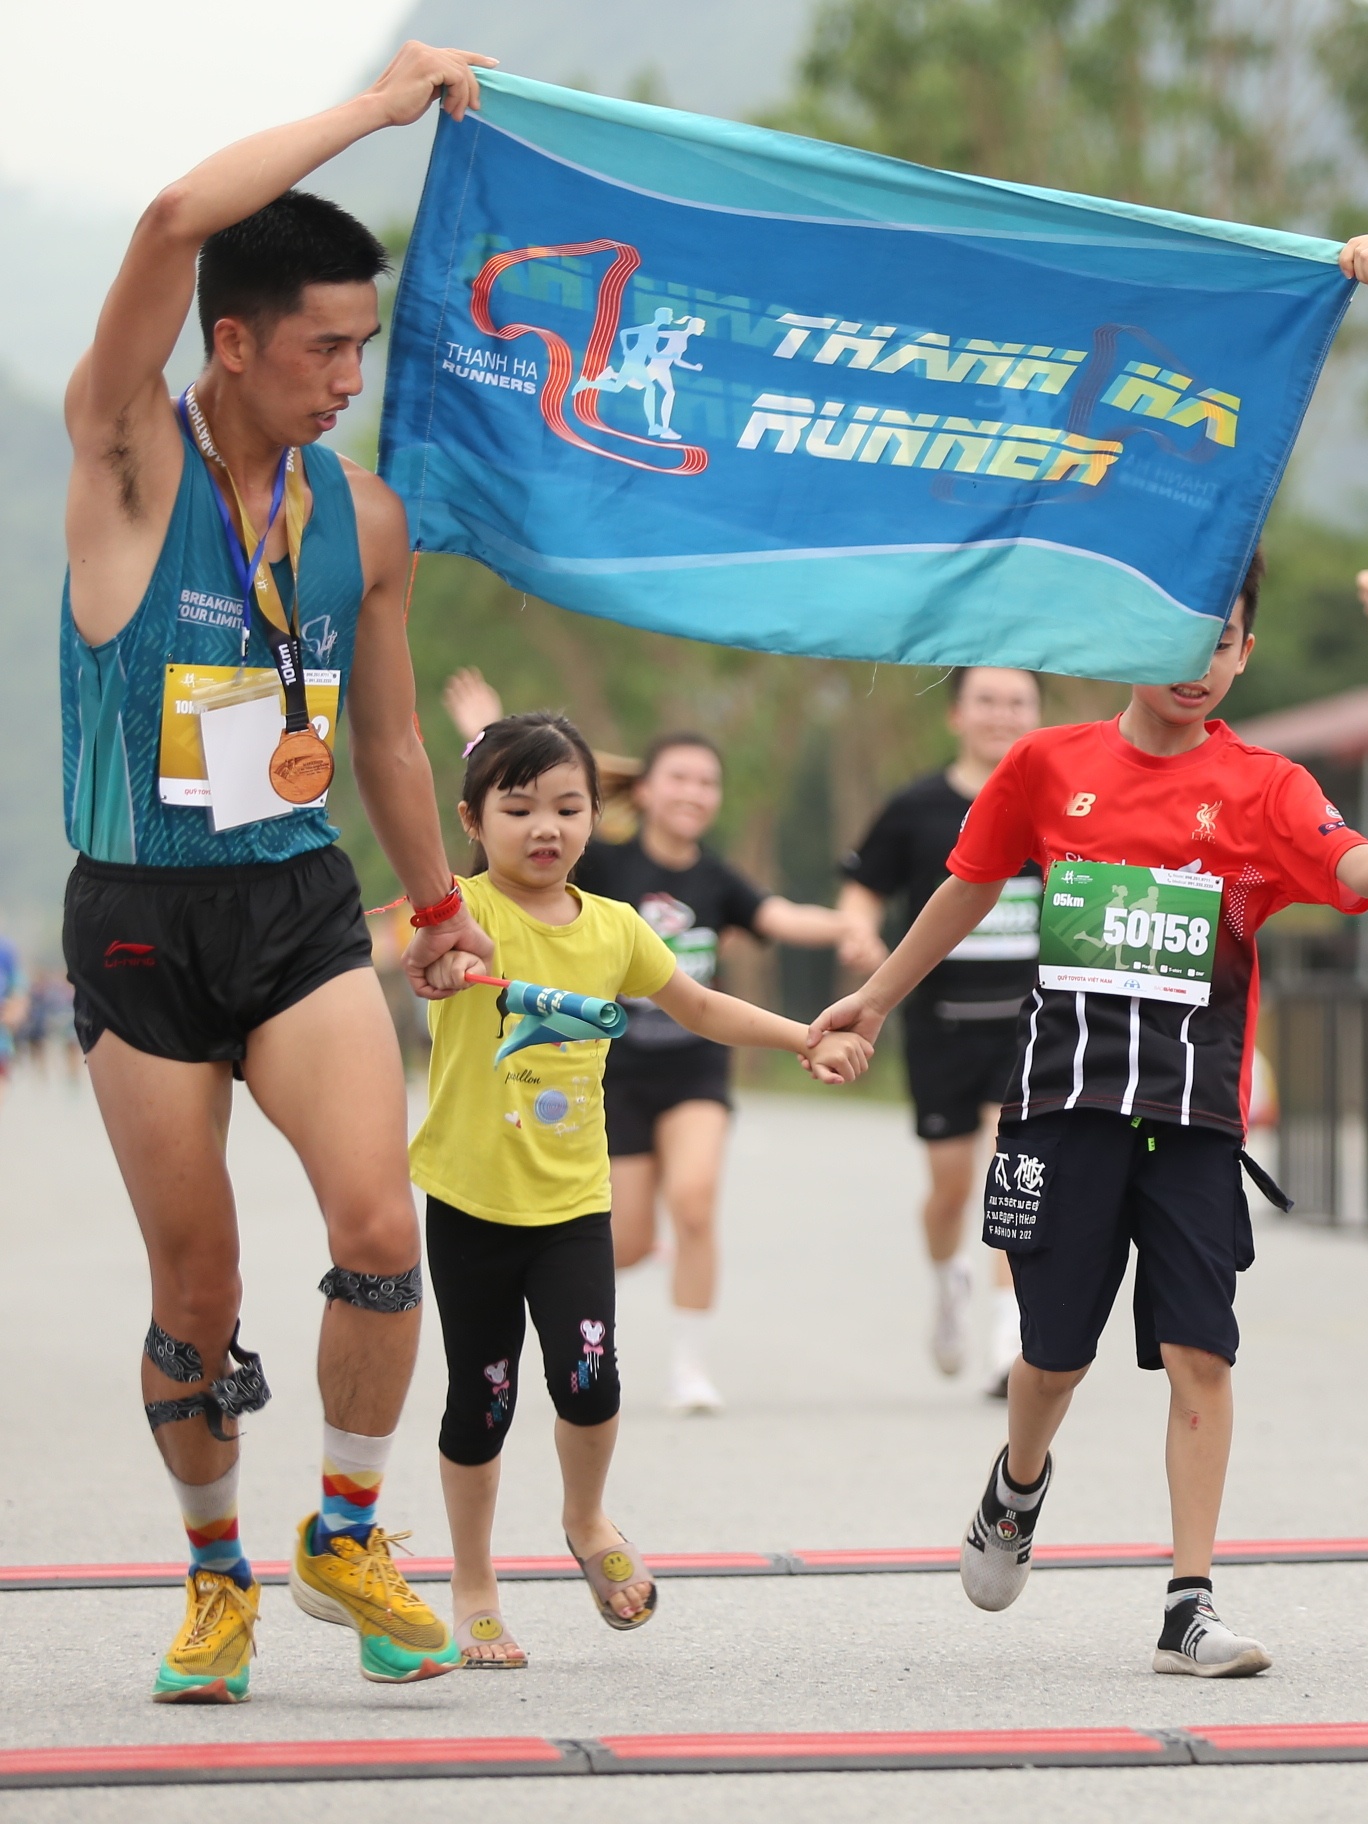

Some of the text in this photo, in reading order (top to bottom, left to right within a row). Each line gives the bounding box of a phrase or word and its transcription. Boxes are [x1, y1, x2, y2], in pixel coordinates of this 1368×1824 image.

[442, 358, 537, 395] RUNNERS
[446, 341, 538, 380] THANH HA
[773, 313, 1241, 448] THANH HA
[736, 393, 1124, 487] RUNNER
[181, 589, 244, 616] BREAKING
[278, 643, 297, 686] 10km
[1053, 892, 1084, 908] 05km
[1102, 907, 1210, 956] 50158
